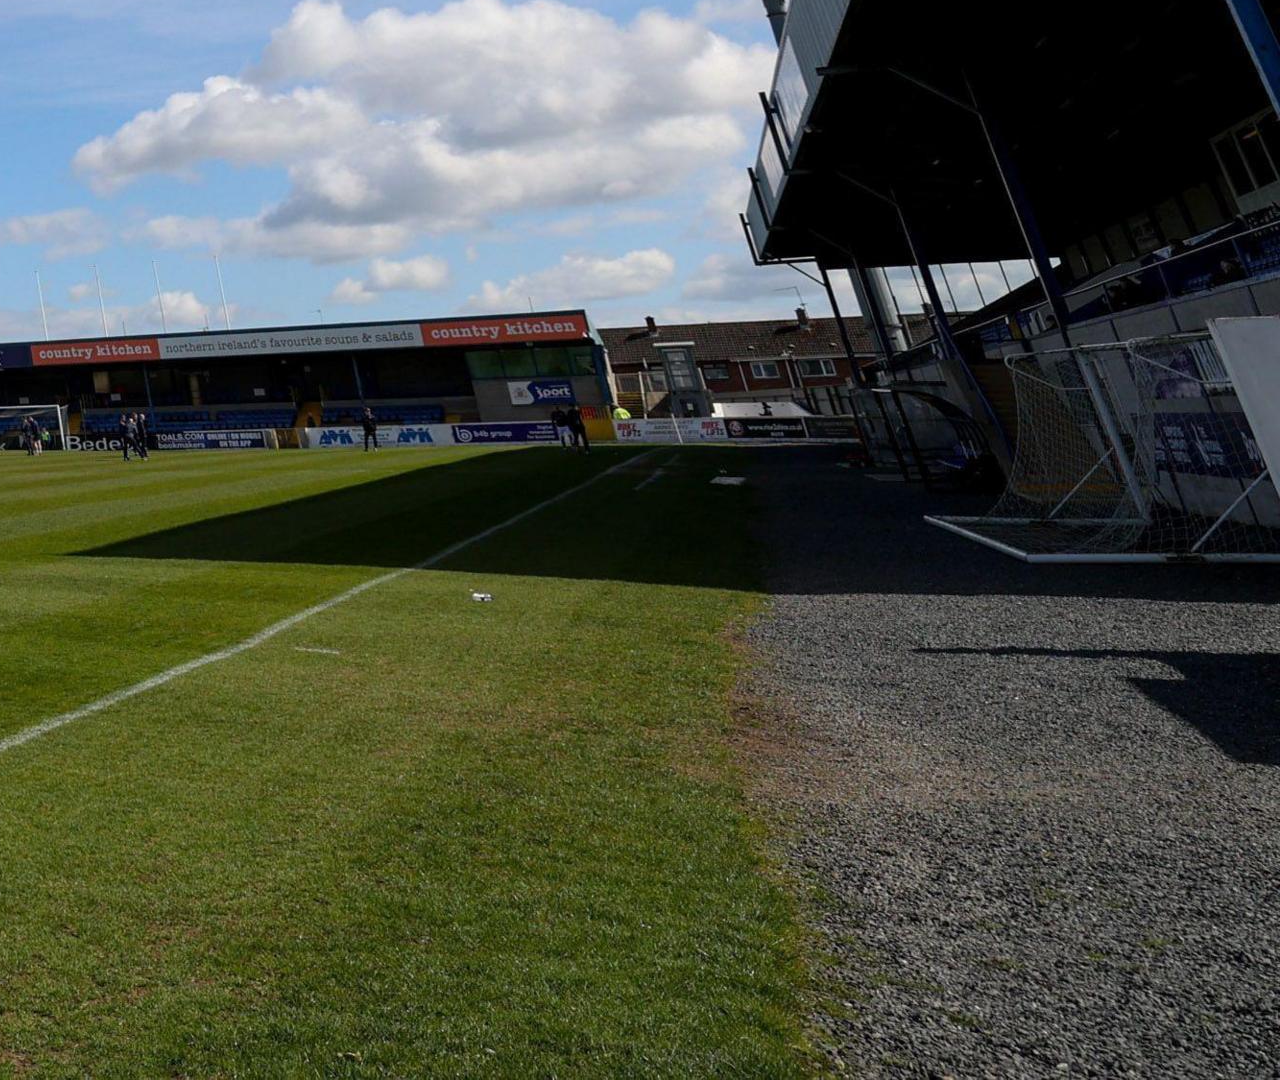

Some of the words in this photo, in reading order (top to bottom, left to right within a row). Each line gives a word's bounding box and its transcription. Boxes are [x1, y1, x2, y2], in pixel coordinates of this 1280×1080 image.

[431, 324, 500, 339] country
[506, 321, 576, 336] kitchen
[165, 341, 215, 354] northern
[218, 338, 267, 351] ireland's
[269, 334, 322, 348] favourite
[324, 333, 359, 346] soups
[361, 332, 372, 343] &
[375, 330, 414, 343] salads
[40, 347, 93, 360] country
[96, 344, 152, 357] kitchen
[156, 432, 205, 441] TOALS.COM
[490, 431, 512, 439] group
[158, 441, 206, 449] bookmakers
